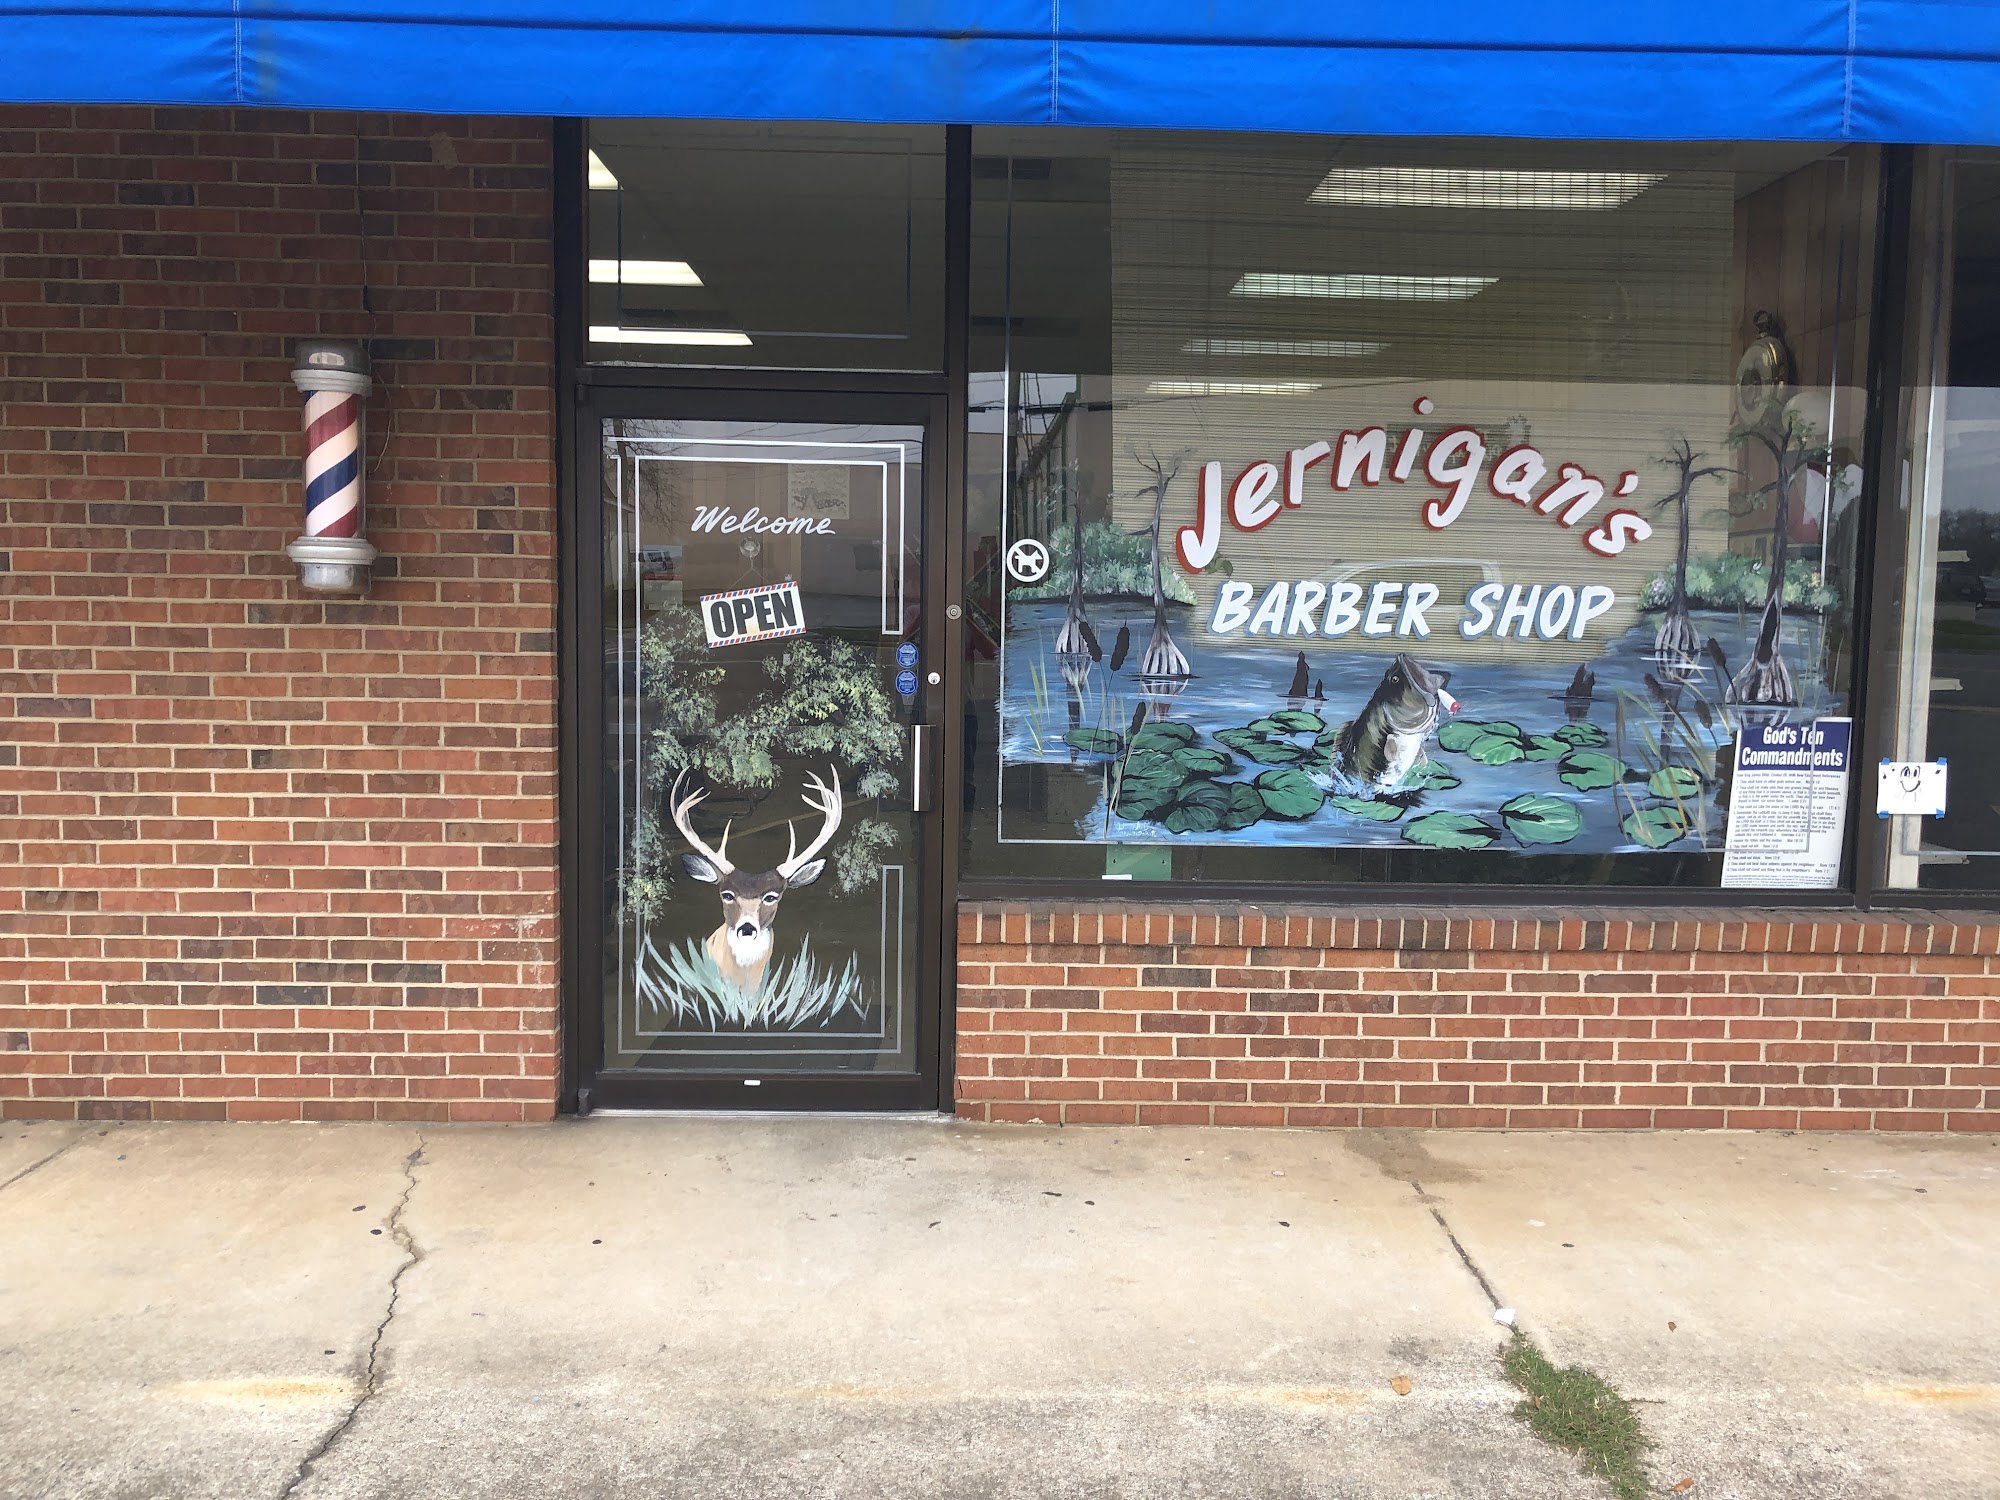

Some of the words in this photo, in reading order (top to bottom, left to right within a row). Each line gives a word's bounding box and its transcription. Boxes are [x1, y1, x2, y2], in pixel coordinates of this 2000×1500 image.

[1177, 396, 1653, 574] Jernigan's
[690, 505, 836, 535] Welcome
[709, 590, 798, 639] OPEN
[1207, 580, 1440, 641] BARBER
[1460, 583, 1616, 641] SHOP
[1762, 727, 1797, 745] God's
[1801, 728, 1824, 745] Ten
[1741, 747, 1843, 766] Commandments
